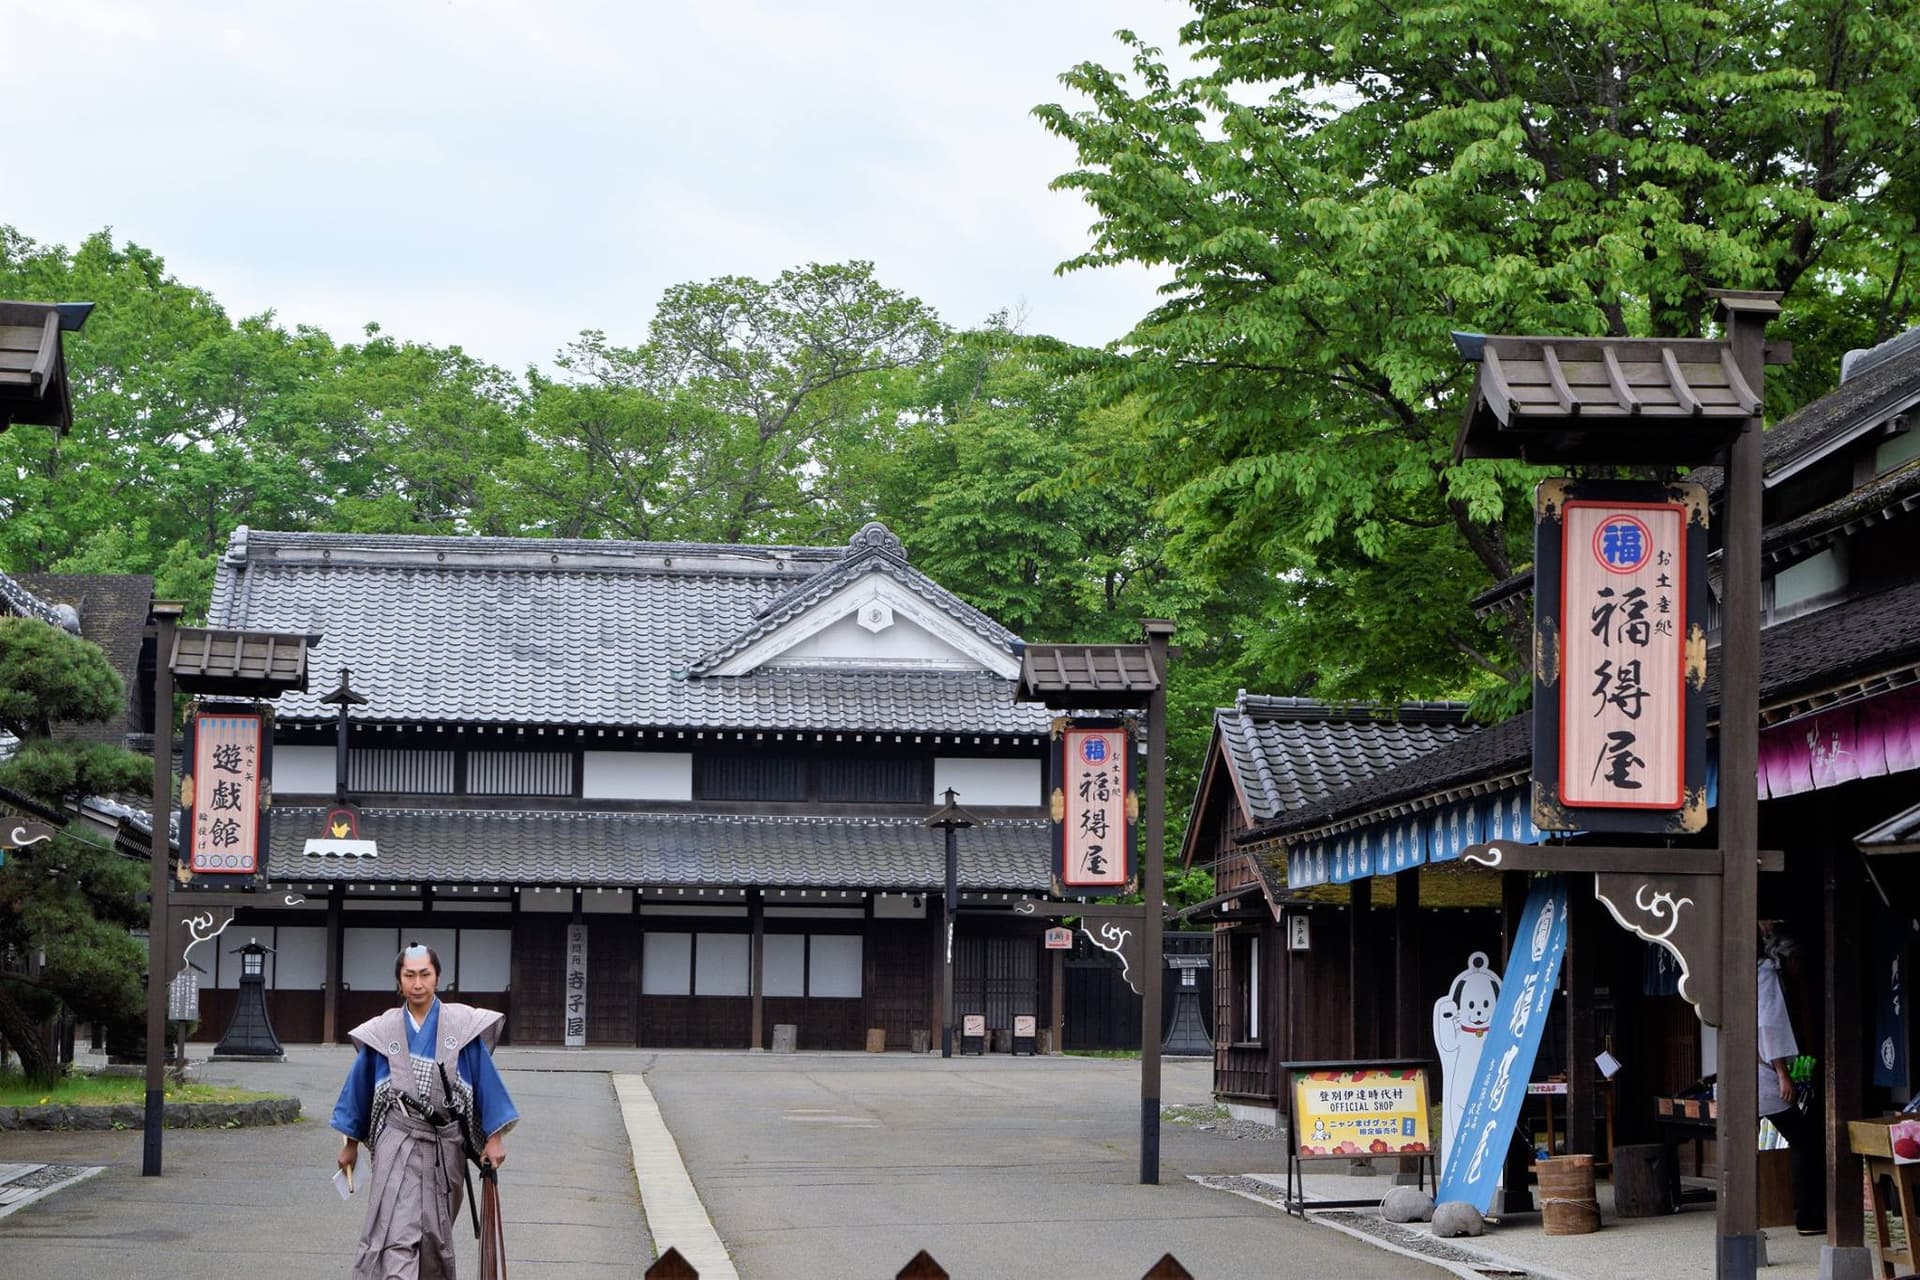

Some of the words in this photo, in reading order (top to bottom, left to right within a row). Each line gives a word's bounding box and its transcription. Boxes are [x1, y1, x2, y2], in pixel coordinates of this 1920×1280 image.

[1602, 524, 1643, 565] 福
[1655, 550, 1673, 638] お土産処
[1590, 586, 1651, 790] 福得屋
[1085, 739, 1105, 761] 福
[210, 743, 243, 849] 遊戯館
[1079, 771, 1111, 876] 福得屋
[1320, 1088, 1403, 1102] 登別伊達時代村
[1330, 1102, 1369, 1112] OFFICIAL
[1374, 1101, 1394, 1111] SHOP
